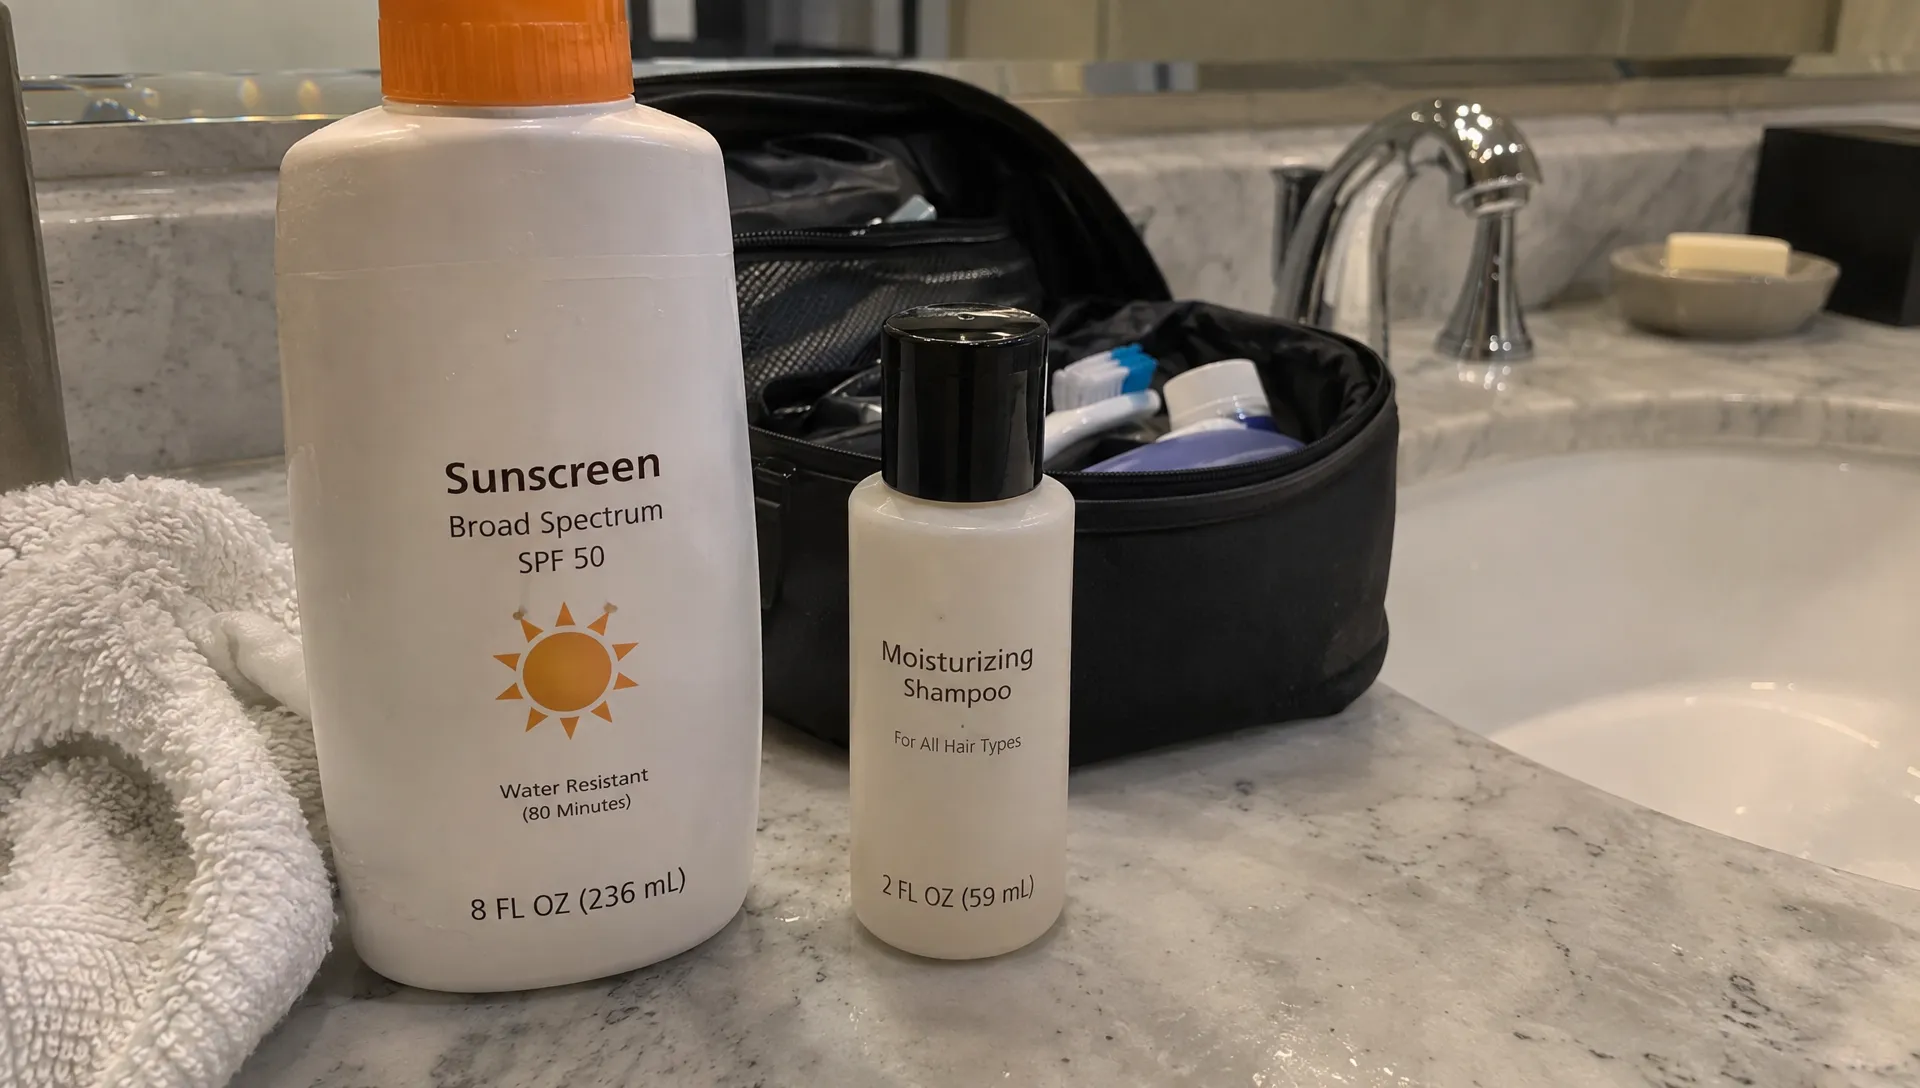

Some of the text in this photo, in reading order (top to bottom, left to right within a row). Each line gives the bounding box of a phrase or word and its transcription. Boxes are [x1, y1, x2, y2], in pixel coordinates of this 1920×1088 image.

[446, 454, 659, 494] Sunscreen
[450, 504, 662, 538] Broad Spectrum
[519, 546, 604, 573] SPF 50
[883, 640, 1032, 672] Moisturizing
[904, 678, 1011, 708] Shampoo
[895, 731, 1021, 756] For All Hair Types
[500, 769, 648, 798] Water Resistant
[523, 793, 631, 823] (80 Minutes)
[472, 867, 685, 920] 8 FL OZ (236 mL)
[883, 875, 1033, 911] 2 FL OZ (59 mL)
